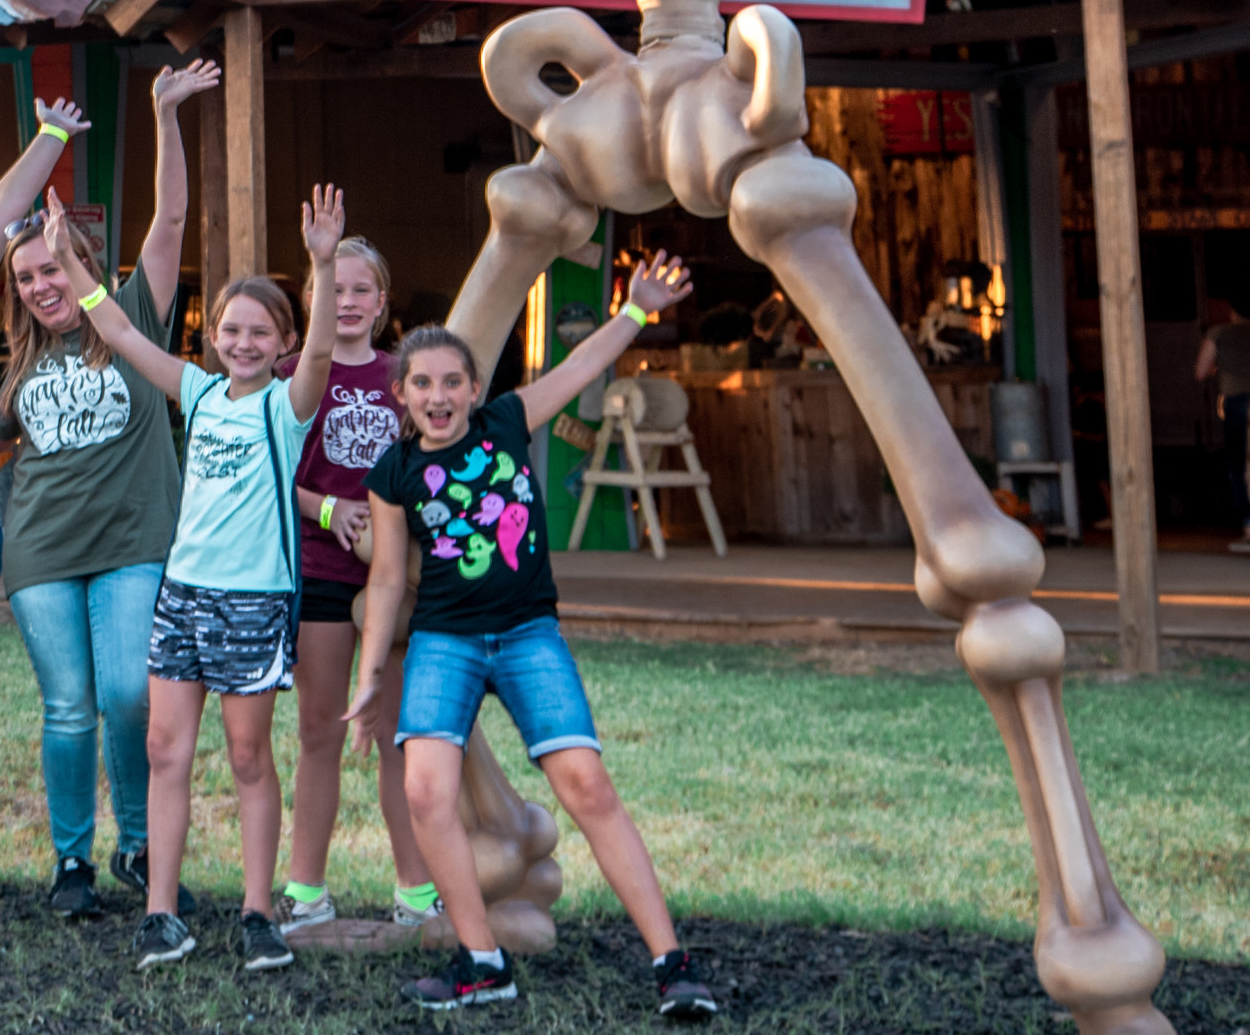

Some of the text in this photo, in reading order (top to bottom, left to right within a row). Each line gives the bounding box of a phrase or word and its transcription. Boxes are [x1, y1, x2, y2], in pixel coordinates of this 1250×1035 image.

[51, 408, 112, 448] fall
[329, 409, 397, 440] happy
[344, 438, 382, 465] fall
